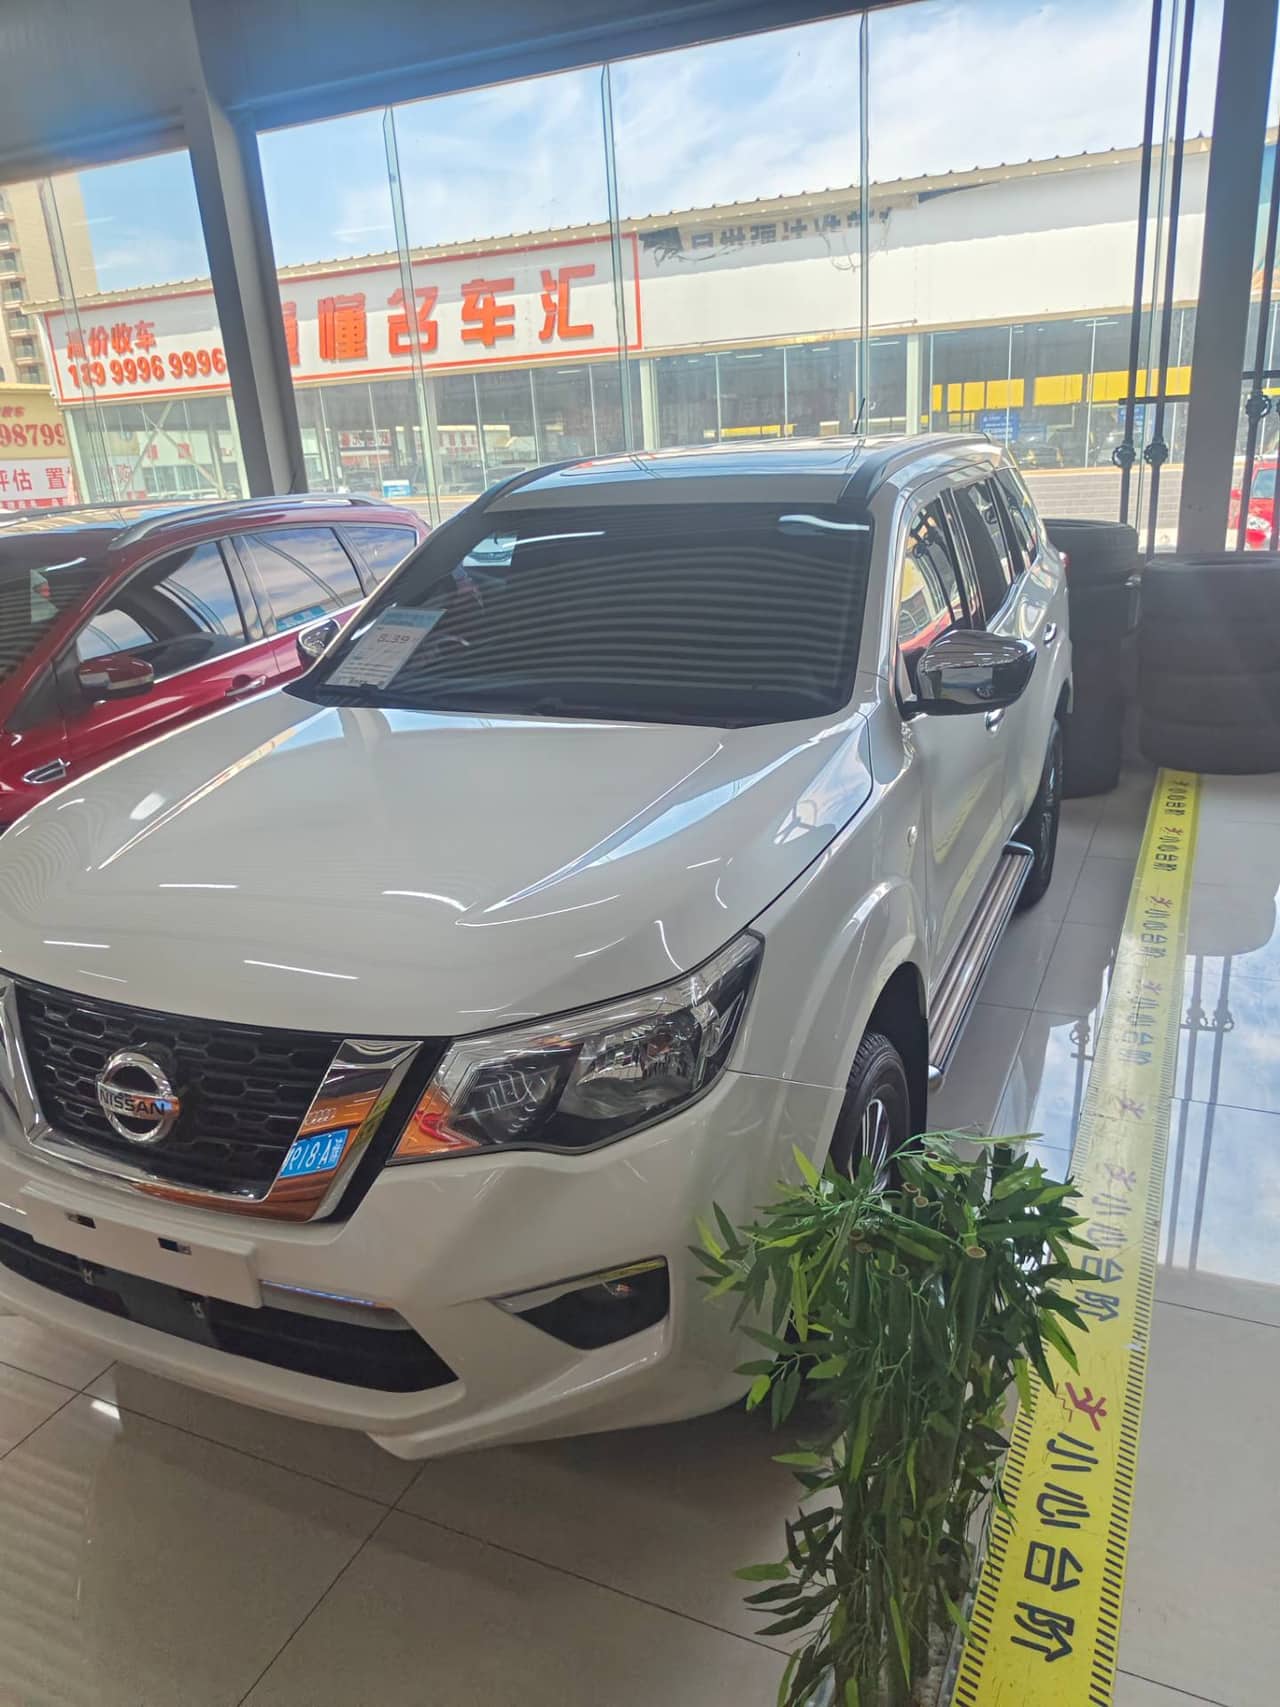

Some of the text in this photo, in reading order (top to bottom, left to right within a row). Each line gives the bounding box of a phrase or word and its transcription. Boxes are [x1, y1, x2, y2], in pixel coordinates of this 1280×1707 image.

[109, 355, 165, 385] 9996
[168, 347, 226, 380] 9996
[1153, 835, 1181, 872] 小心台阶
[1136, 908, 1171, 958] 小心台阶
[100, 1088, 166, 1115] NISSAN
[1074, 1192, 1132, 1322] 小心台阶
[1010, 1432, 1099, 1662] 小心台阶
